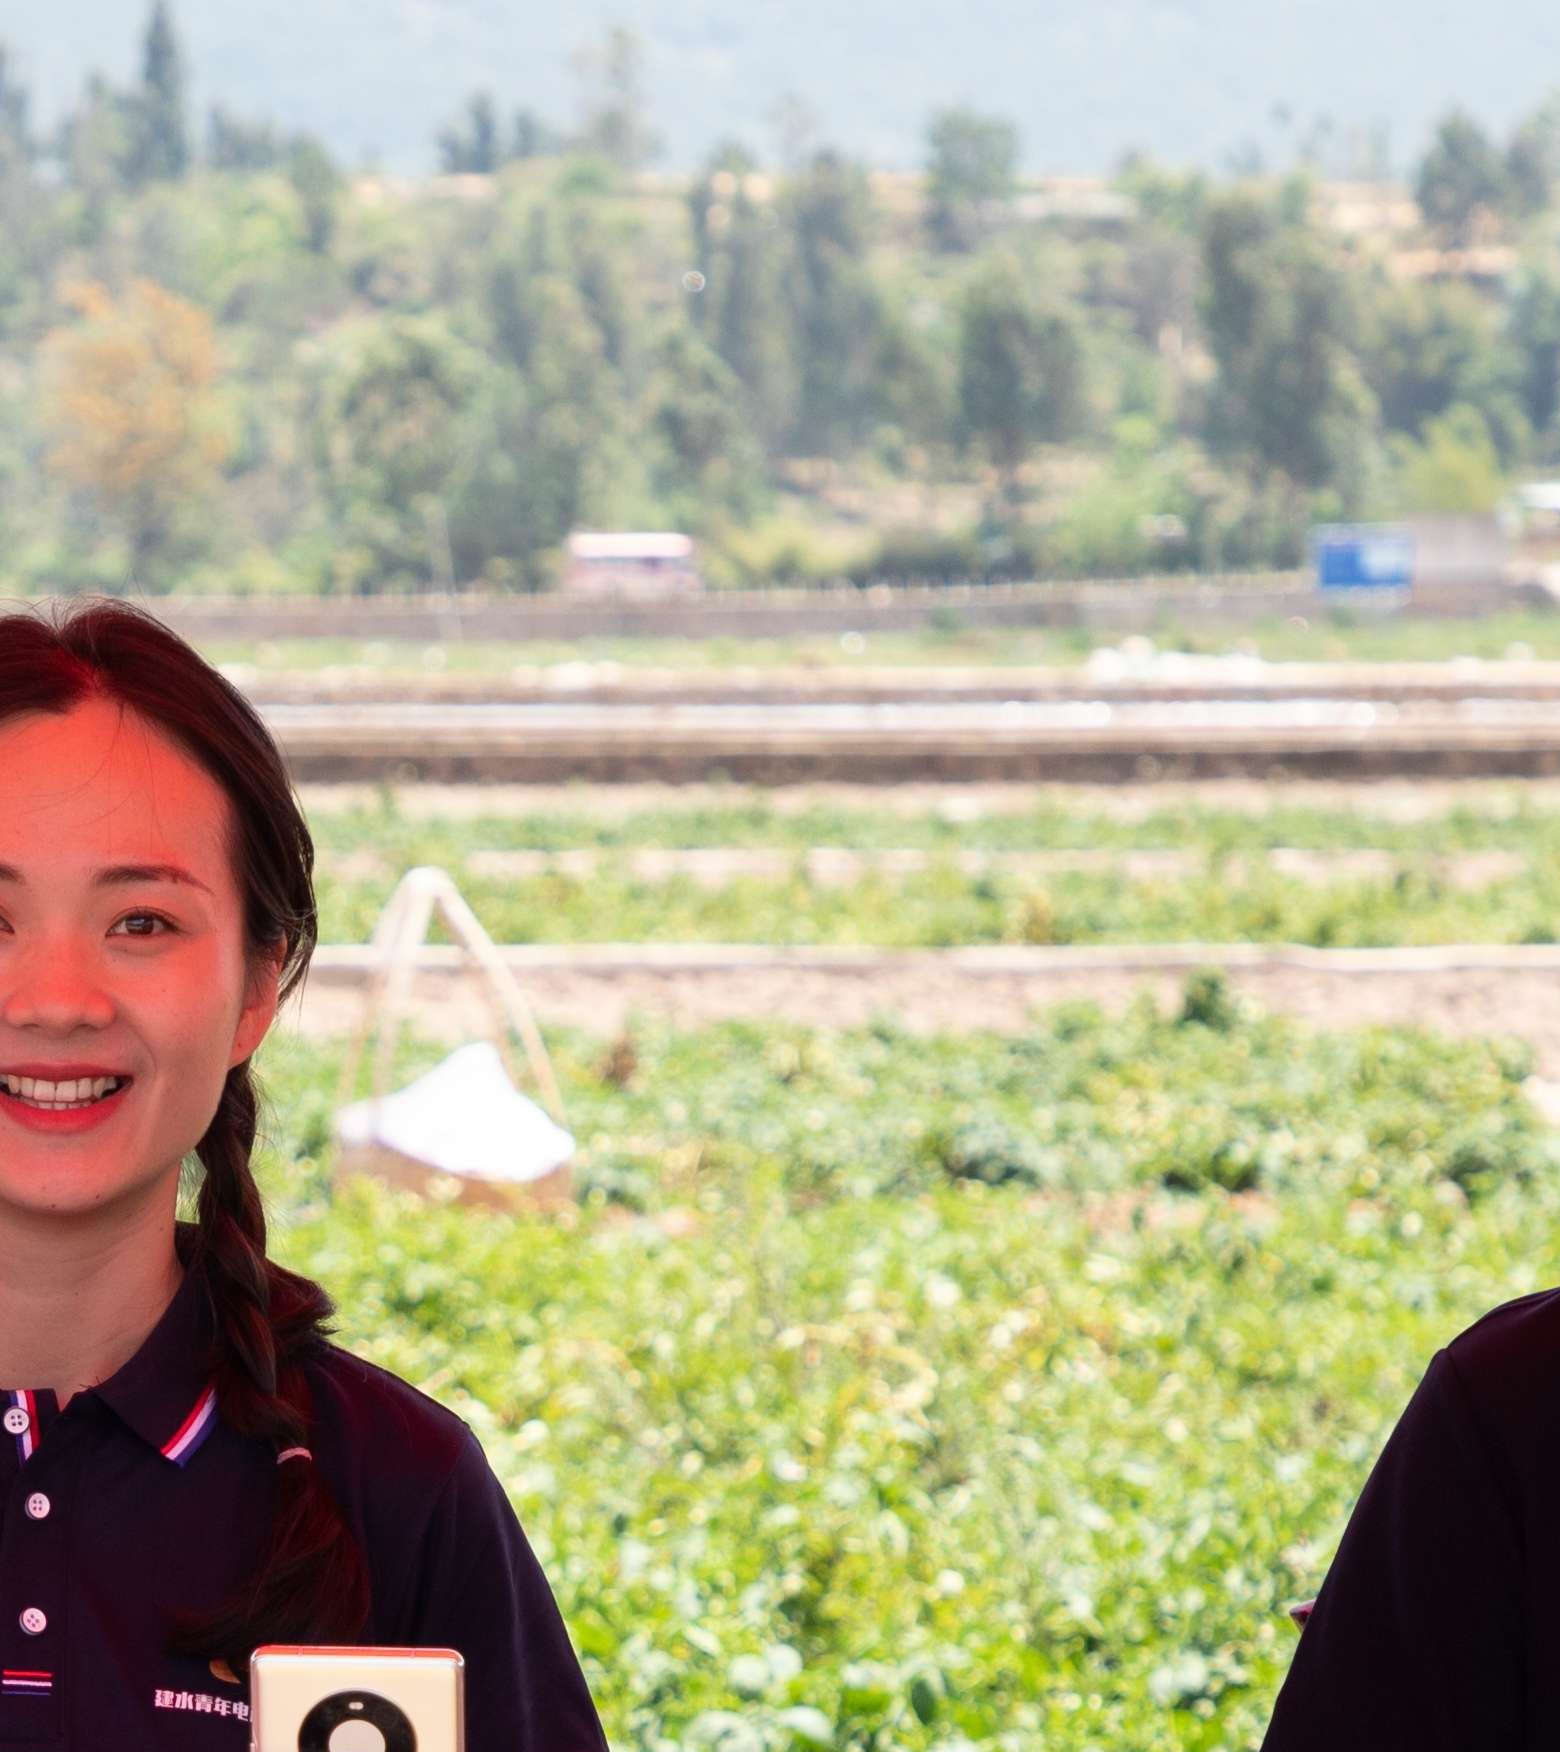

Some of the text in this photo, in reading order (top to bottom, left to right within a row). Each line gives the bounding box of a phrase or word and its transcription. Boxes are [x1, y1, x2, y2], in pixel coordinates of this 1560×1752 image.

[155, 1689, 252, 1722] 建水青年电
